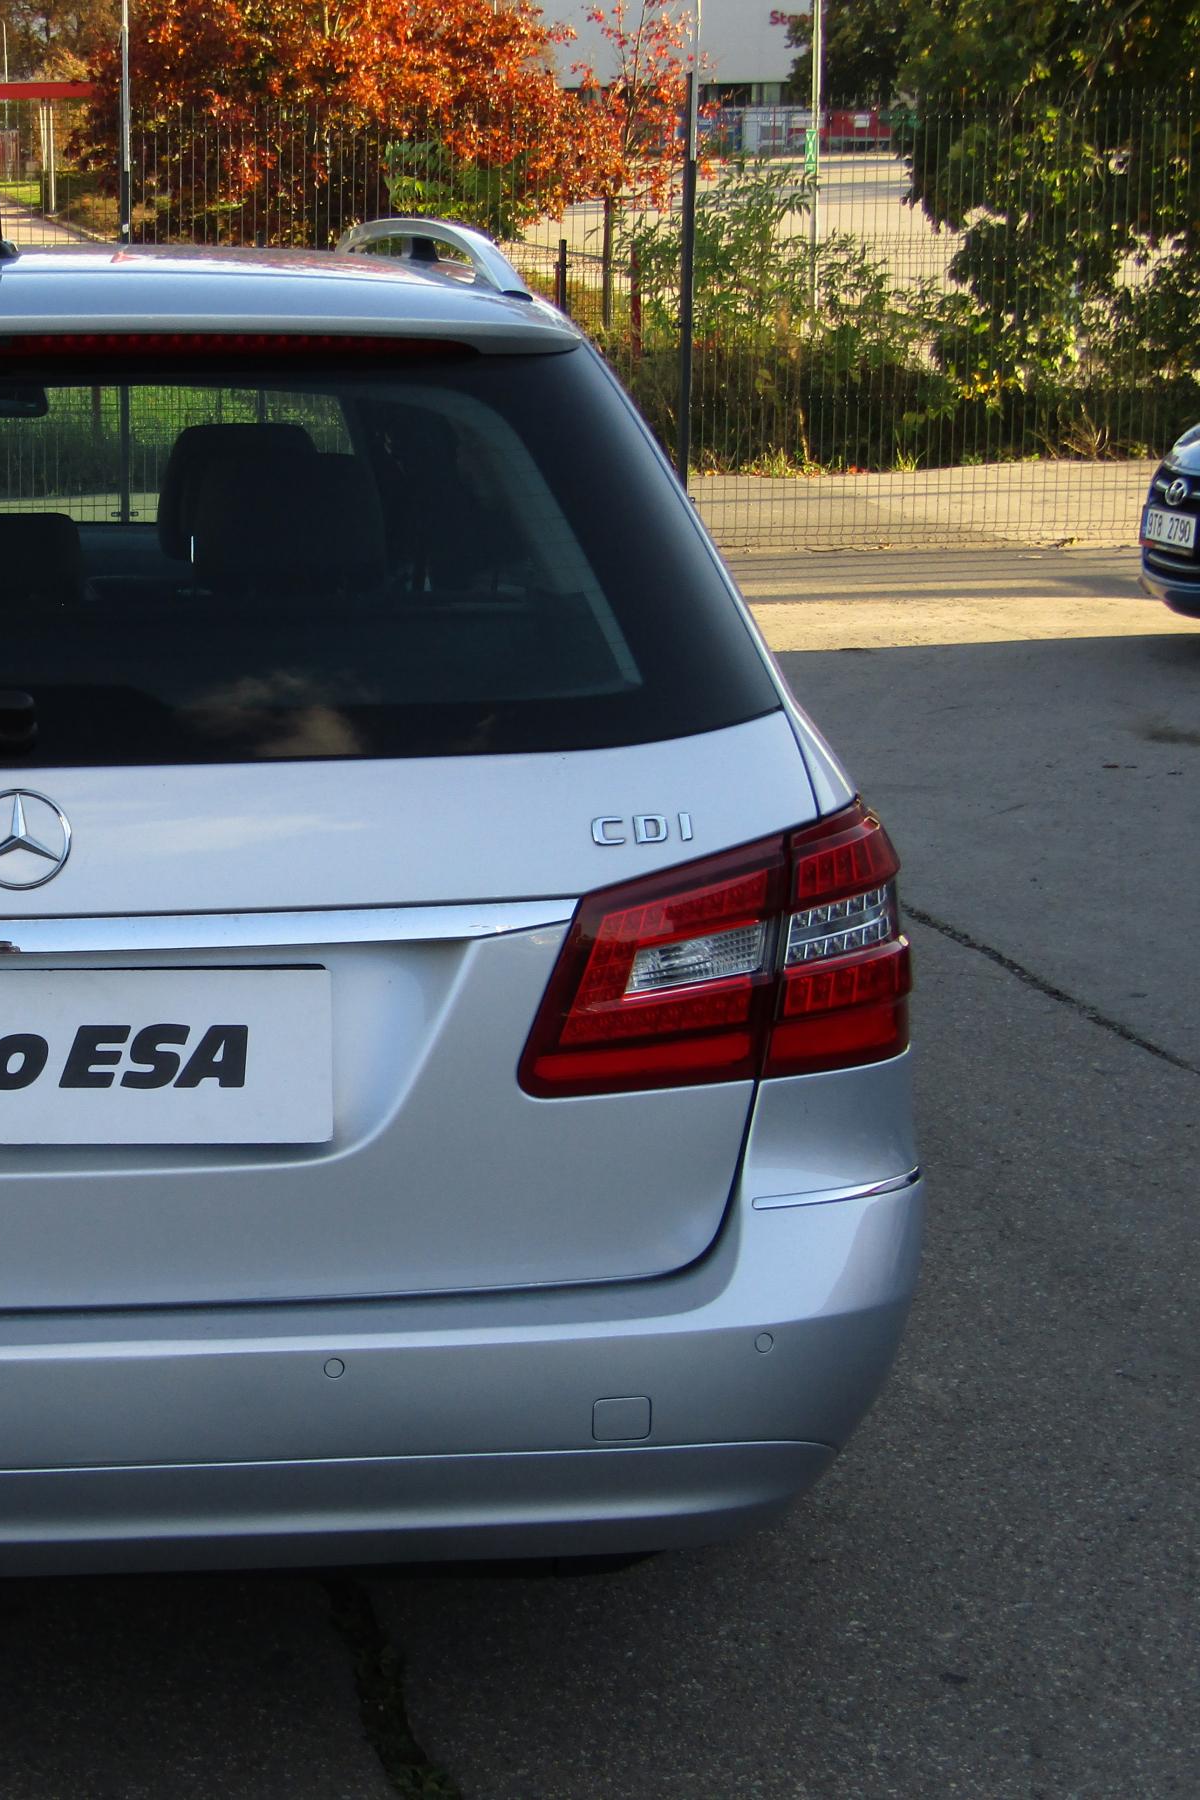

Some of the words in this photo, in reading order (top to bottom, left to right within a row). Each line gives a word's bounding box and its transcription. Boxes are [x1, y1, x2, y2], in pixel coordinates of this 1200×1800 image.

[1167, 516, 1191, 544] 2790
[591, 812, 693, 846] CDI
[58, 1024, 249, 1090] ESA
